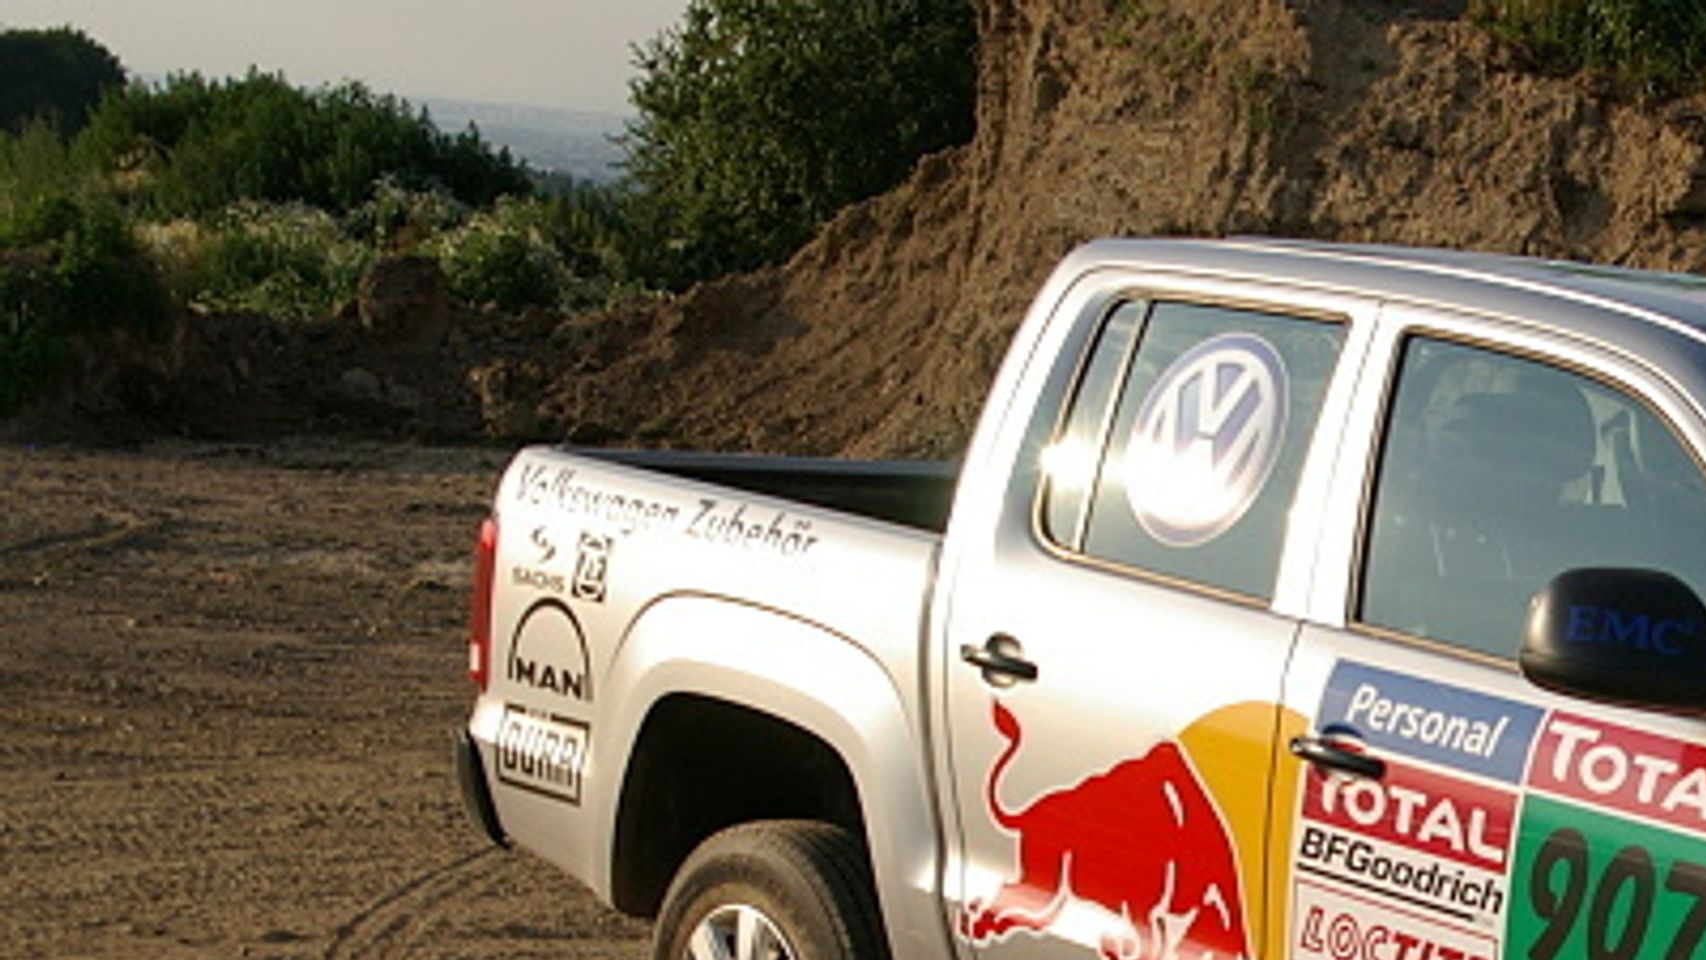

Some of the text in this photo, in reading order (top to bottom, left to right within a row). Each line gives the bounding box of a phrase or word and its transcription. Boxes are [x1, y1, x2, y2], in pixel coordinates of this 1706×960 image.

[515, 656, 583, 701] MAN
[1345, 683, 1509, 758] Personal
[1319, 770, 1505, 864] TOTAL
[1300, 826, 1504, 915] BFGoodrich
